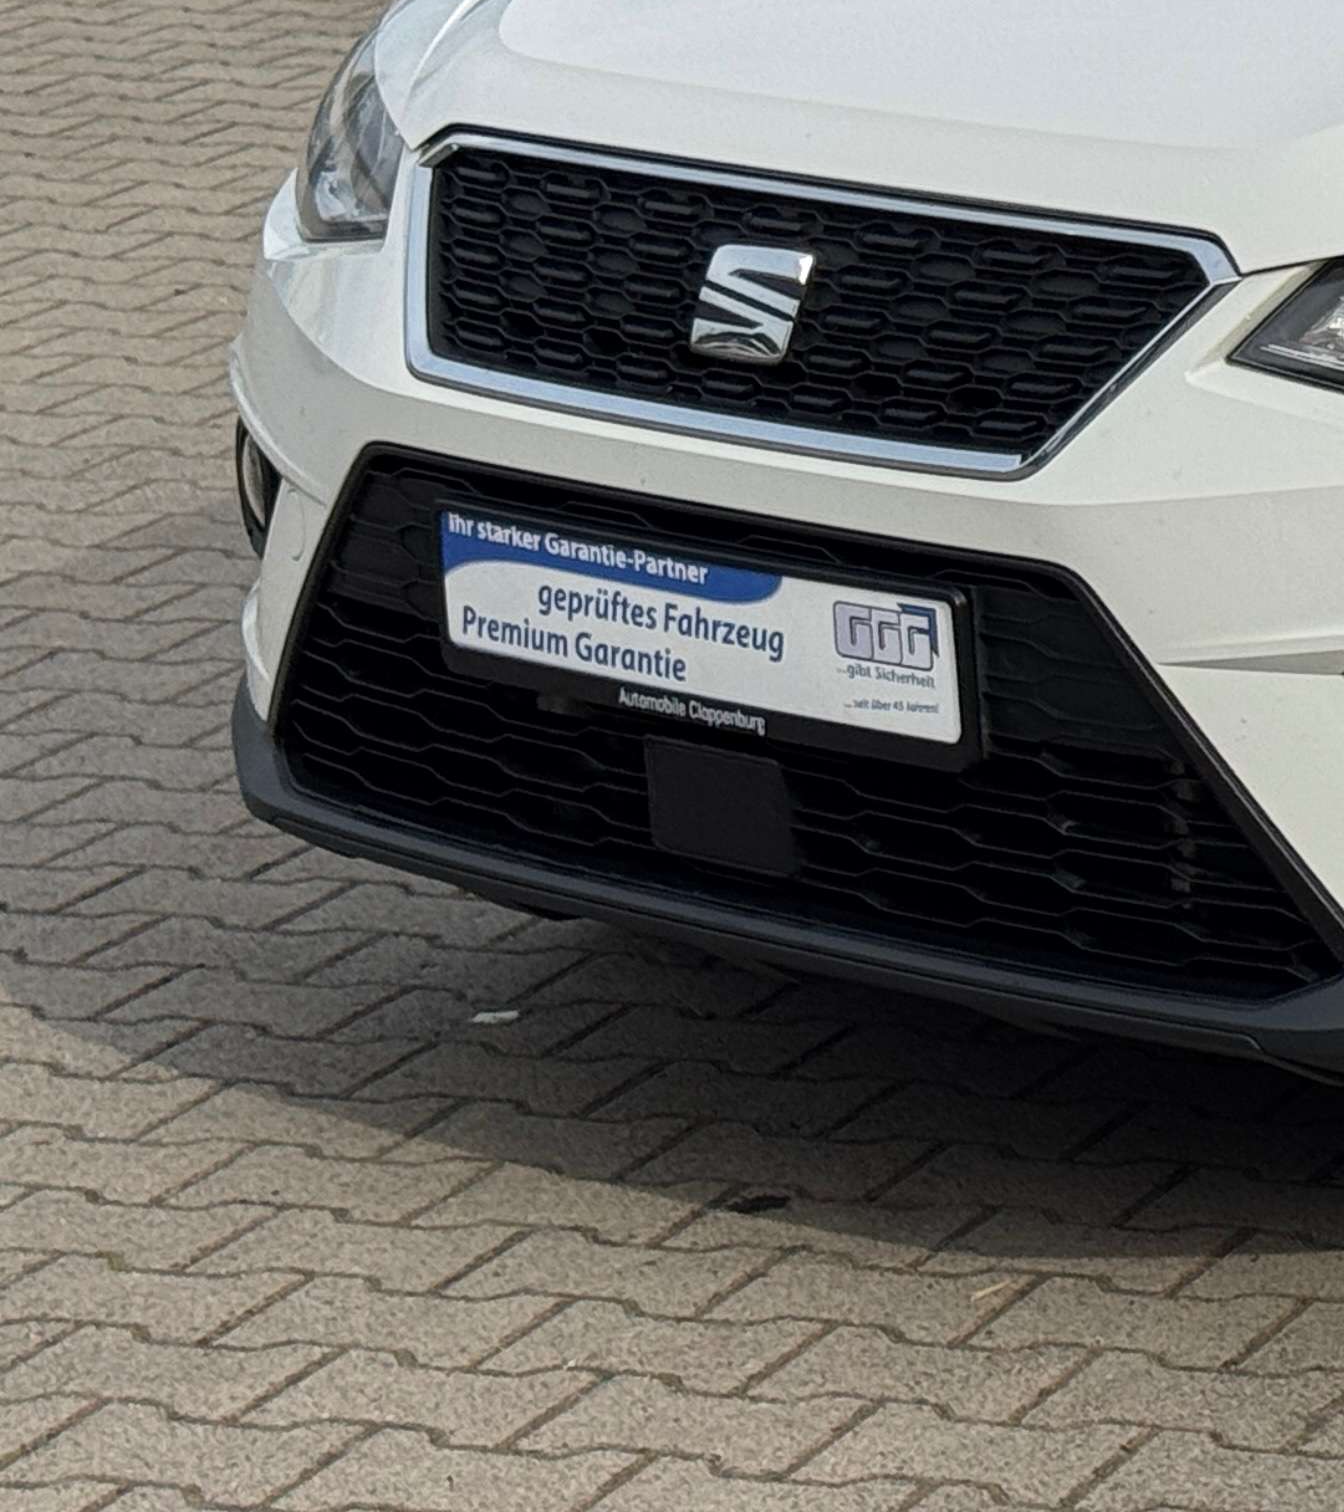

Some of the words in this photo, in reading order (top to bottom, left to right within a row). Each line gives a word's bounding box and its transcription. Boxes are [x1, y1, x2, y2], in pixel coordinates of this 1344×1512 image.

[449, 512, 474, 536] Ihr
[477, 519, 541, 551] starker
[544, 532, 709, 585] Garantie-Partner
[462, 604, 568, 658] Premium
[575, 631, 687, 681] Garantie
[538, 584, 657, 629] geprüftes
[664, 602, 784, 663] Fahrzeug
[618, 687, 687, 717] Automobile
[689, 700, 766, 736] Cloppenburg
